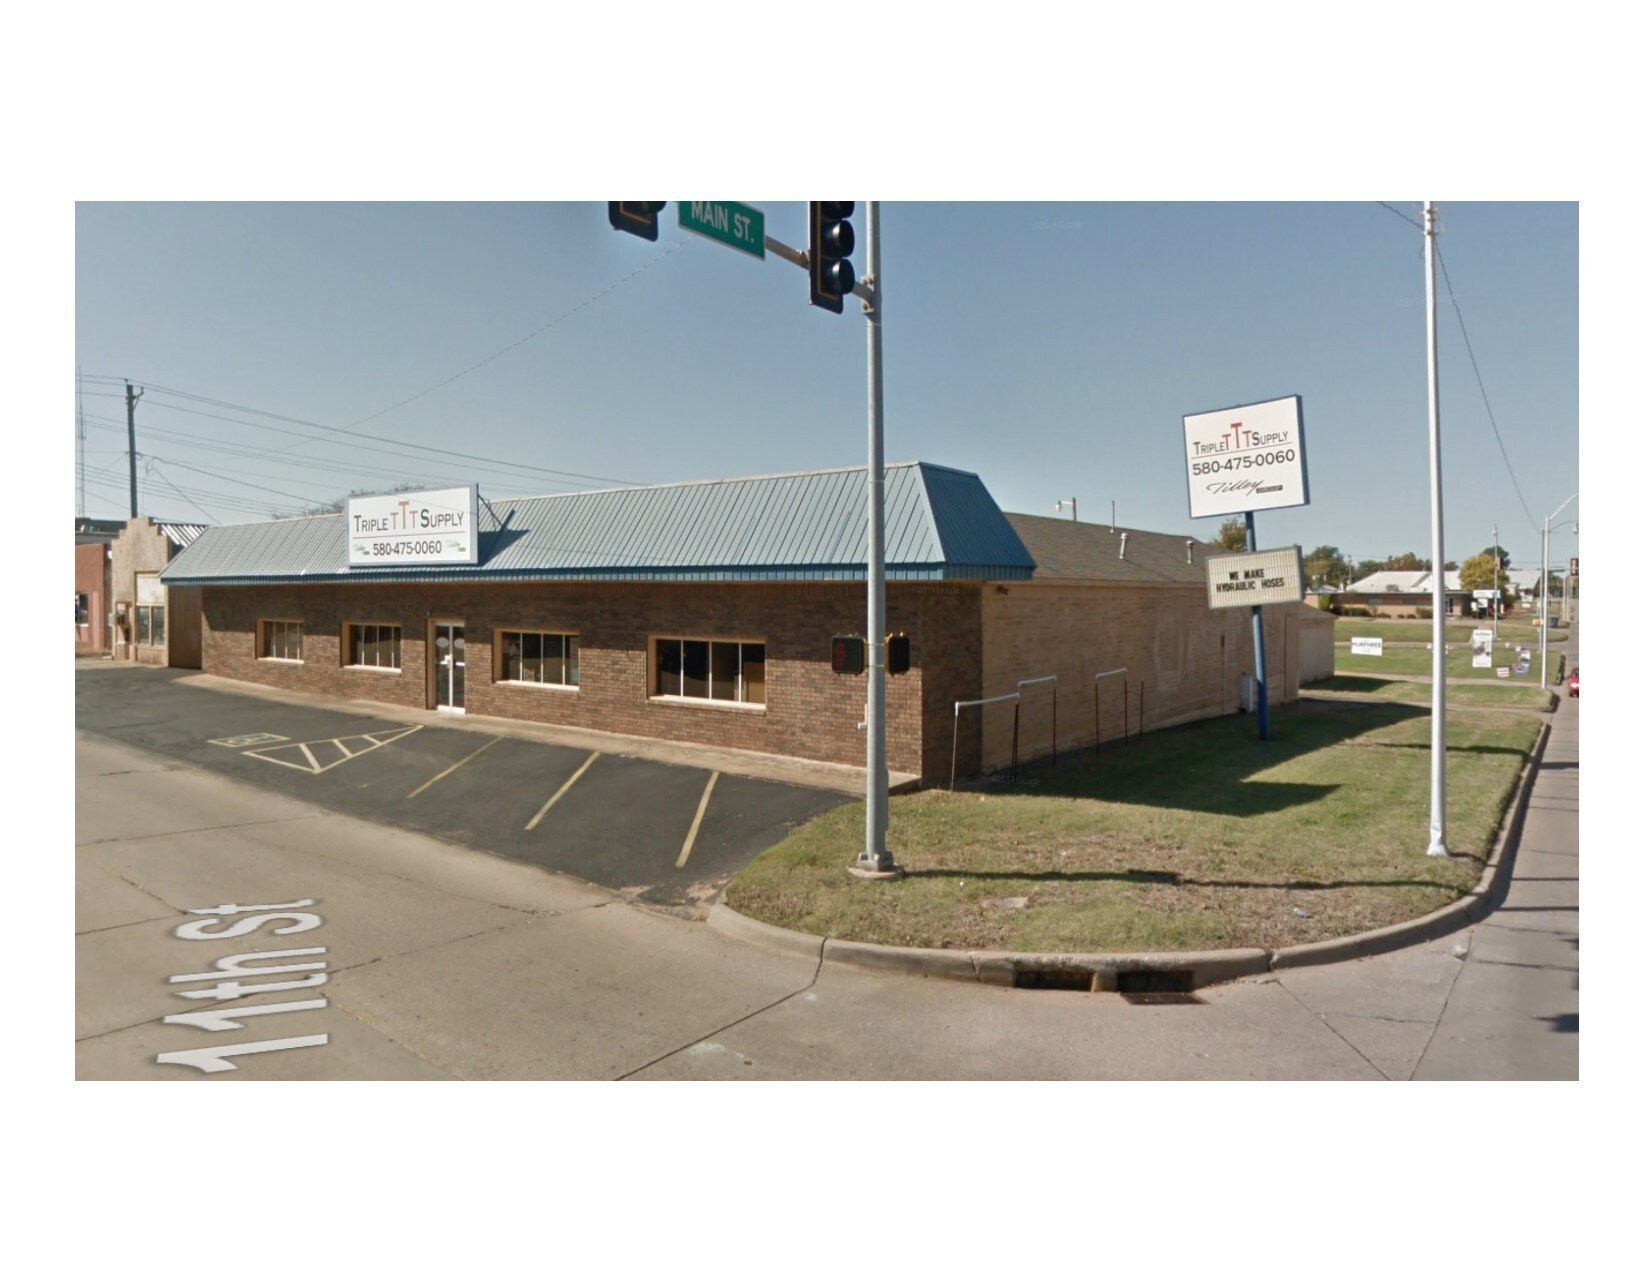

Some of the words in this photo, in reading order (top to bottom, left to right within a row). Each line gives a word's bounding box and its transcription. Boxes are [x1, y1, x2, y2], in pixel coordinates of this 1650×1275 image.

[691, 201, 729, 232] MAIN
[733, 213, 754, 244] ST.
[1192, 449, 1296, 476] 580-475-0060
[420, 508, 464, 528] SUPPLY
[373, 540, 442, 556] 580-475-0060
[1228, 571, 1240, 581] WE
[1243, 568, 1265, 580] MAKE
[1216, 581, 1256, 592] HYDRAULIC
[1261, 577, 1285, 589] HOSES
